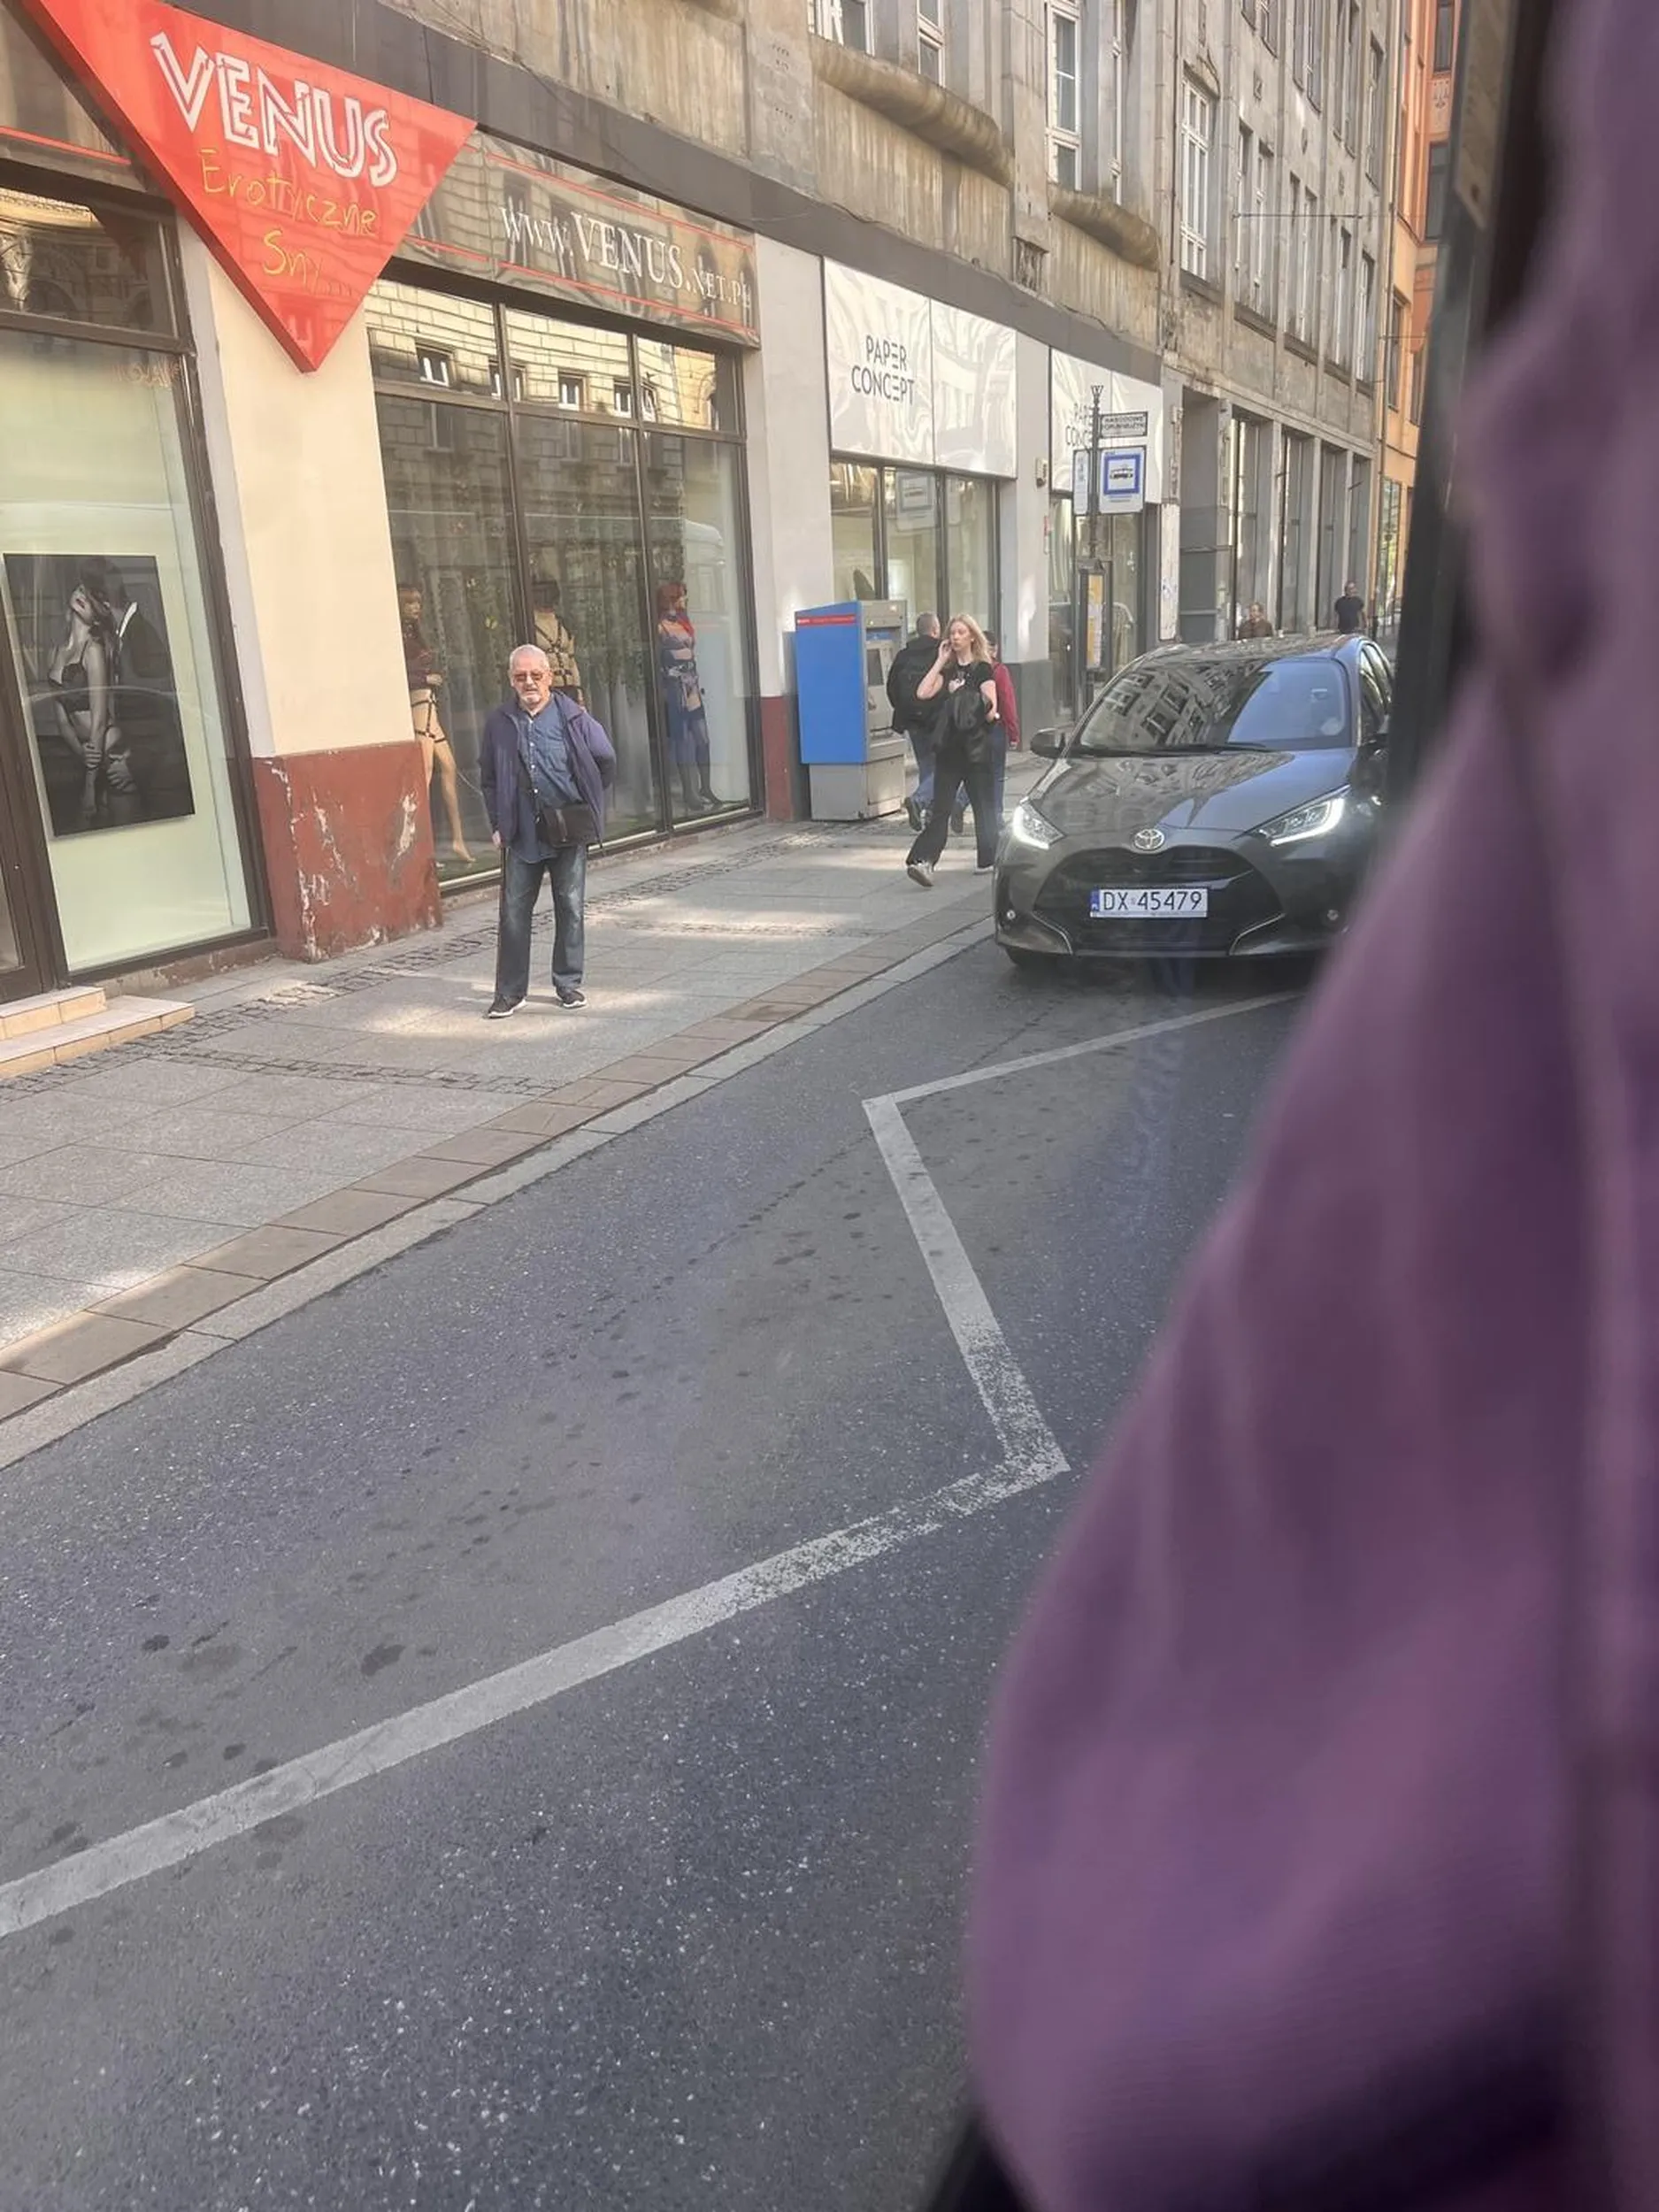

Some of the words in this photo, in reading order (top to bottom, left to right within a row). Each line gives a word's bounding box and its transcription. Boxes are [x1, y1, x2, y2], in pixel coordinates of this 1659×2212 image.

[150, 31, 397, 187] VENUS
[866, 334, 907, 372] PAPER
[851, 365, 915, 406] CONCEPT
[1103, 891, 1129, 910] DX
[1137, 891, 1202, 910] 45479
